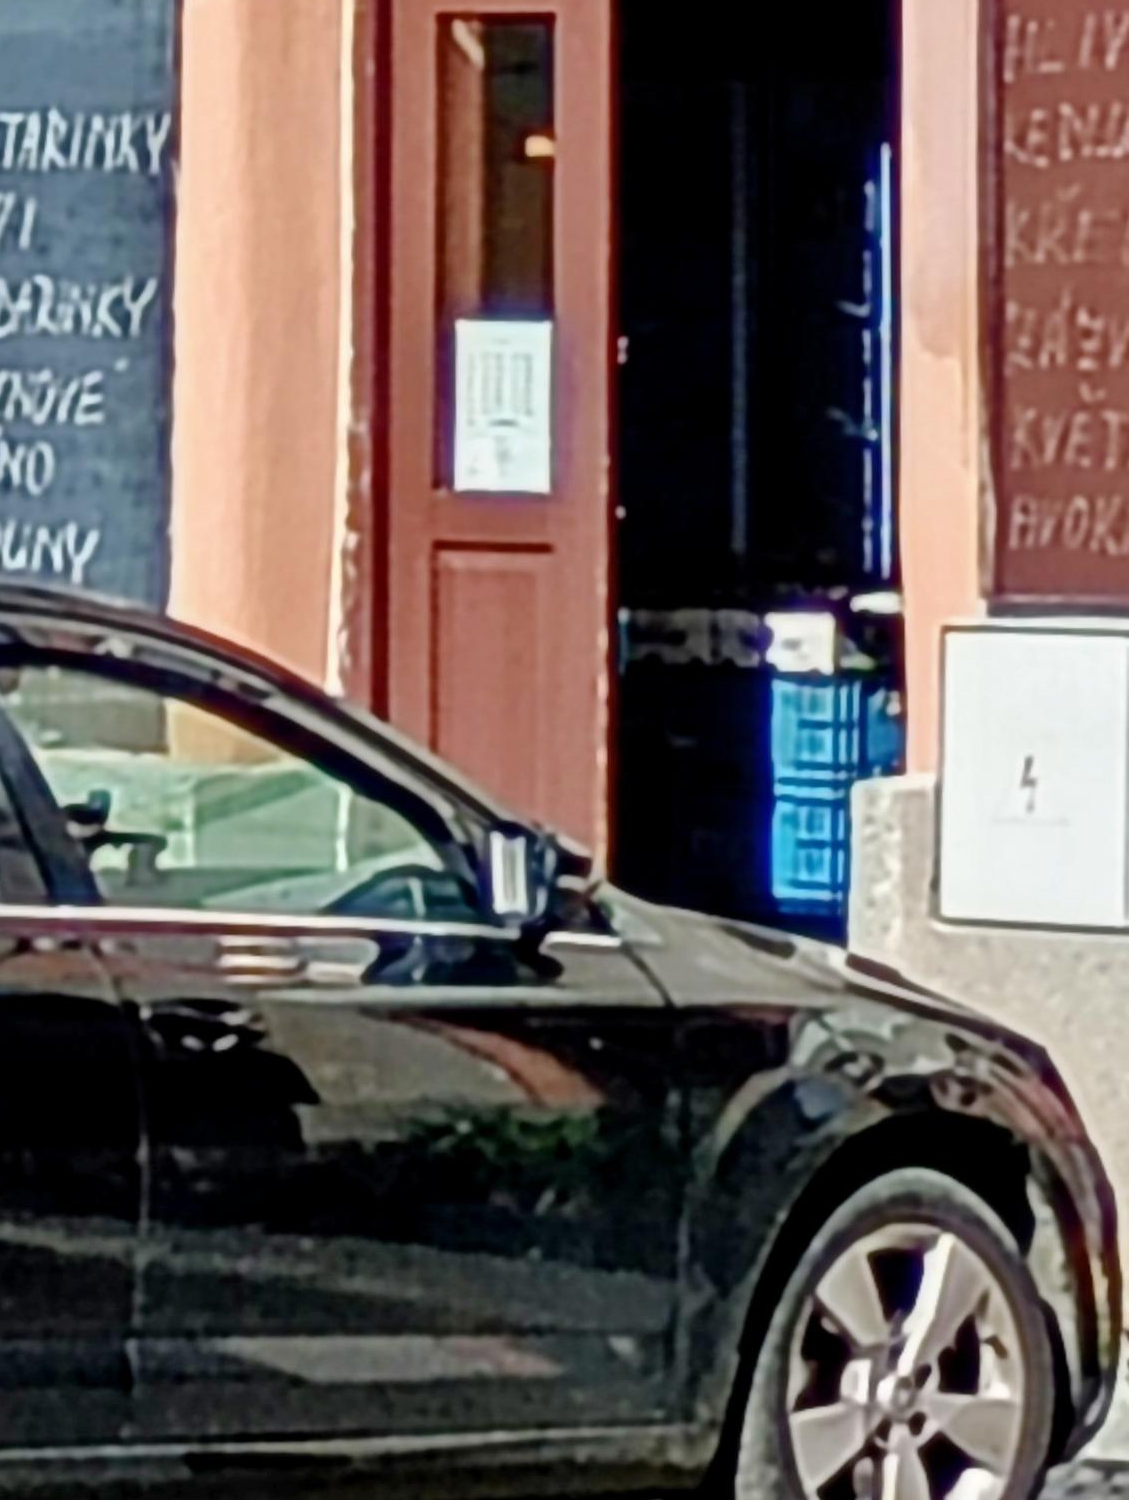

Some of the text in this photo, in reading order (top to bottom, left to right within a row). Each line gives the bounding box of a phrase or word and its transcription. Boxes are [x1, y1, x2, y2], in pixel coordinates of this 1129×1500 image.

[1005, 183, 1129, 269] KŘE
[1011, 381, 1129, 471] KVĚT
[1009, 495, 1129, 557] AVOK
